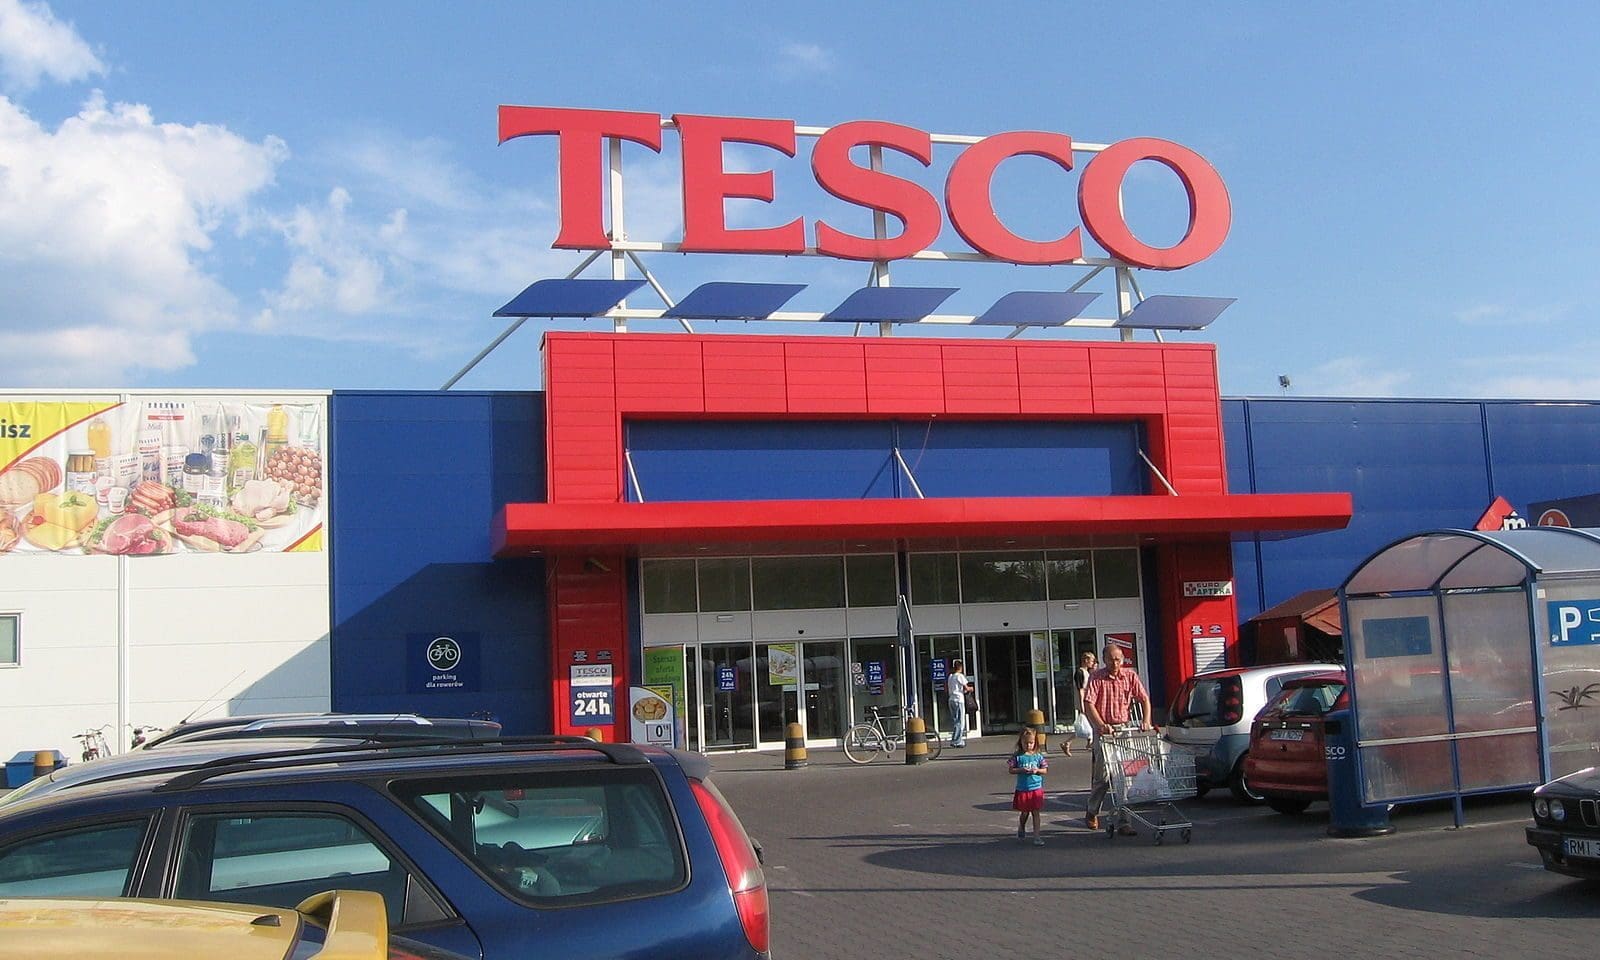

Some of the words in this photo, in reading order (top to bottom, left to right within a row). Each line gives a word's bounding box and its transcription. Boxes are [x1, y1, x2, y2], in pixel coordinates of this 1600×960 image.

[498, 104, 1233, 271] TESCO
[1, 418, 31, 438] isz
[1559, 606, 1582, 641] P
[576, 667, 608, 675] TESCO
[576, 691, 608, 699] otwarte
[574, 698, 611, 716] 24h
